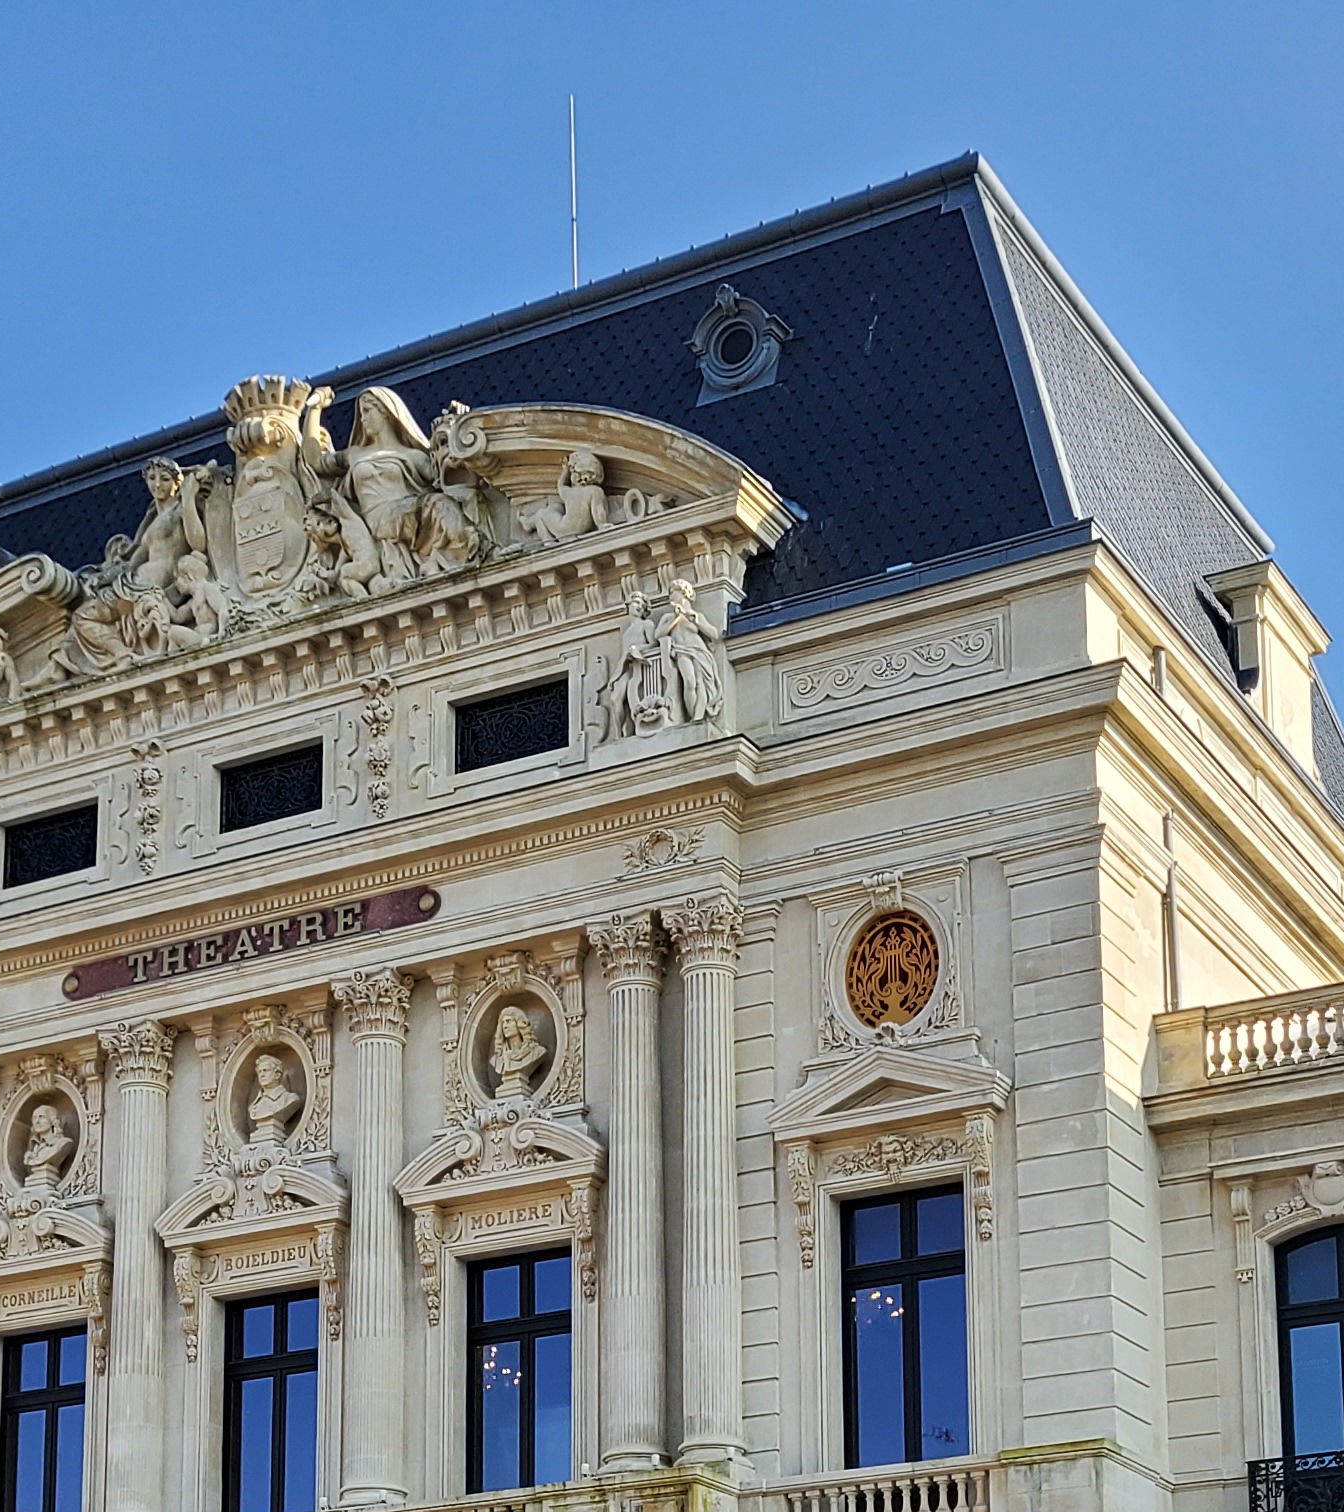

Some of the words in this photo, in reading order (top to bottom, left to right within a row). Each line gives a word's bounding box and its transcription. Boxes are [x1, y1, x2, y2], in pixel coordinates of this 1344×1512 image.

[128, 902, 363, 983] THEATRE
[470, 1203, 552, 1231] MOLIERE
[223, 1245, 308, 1273] BOIELDIEU
[1, 1284, 77, 1309] CORNEILLE
